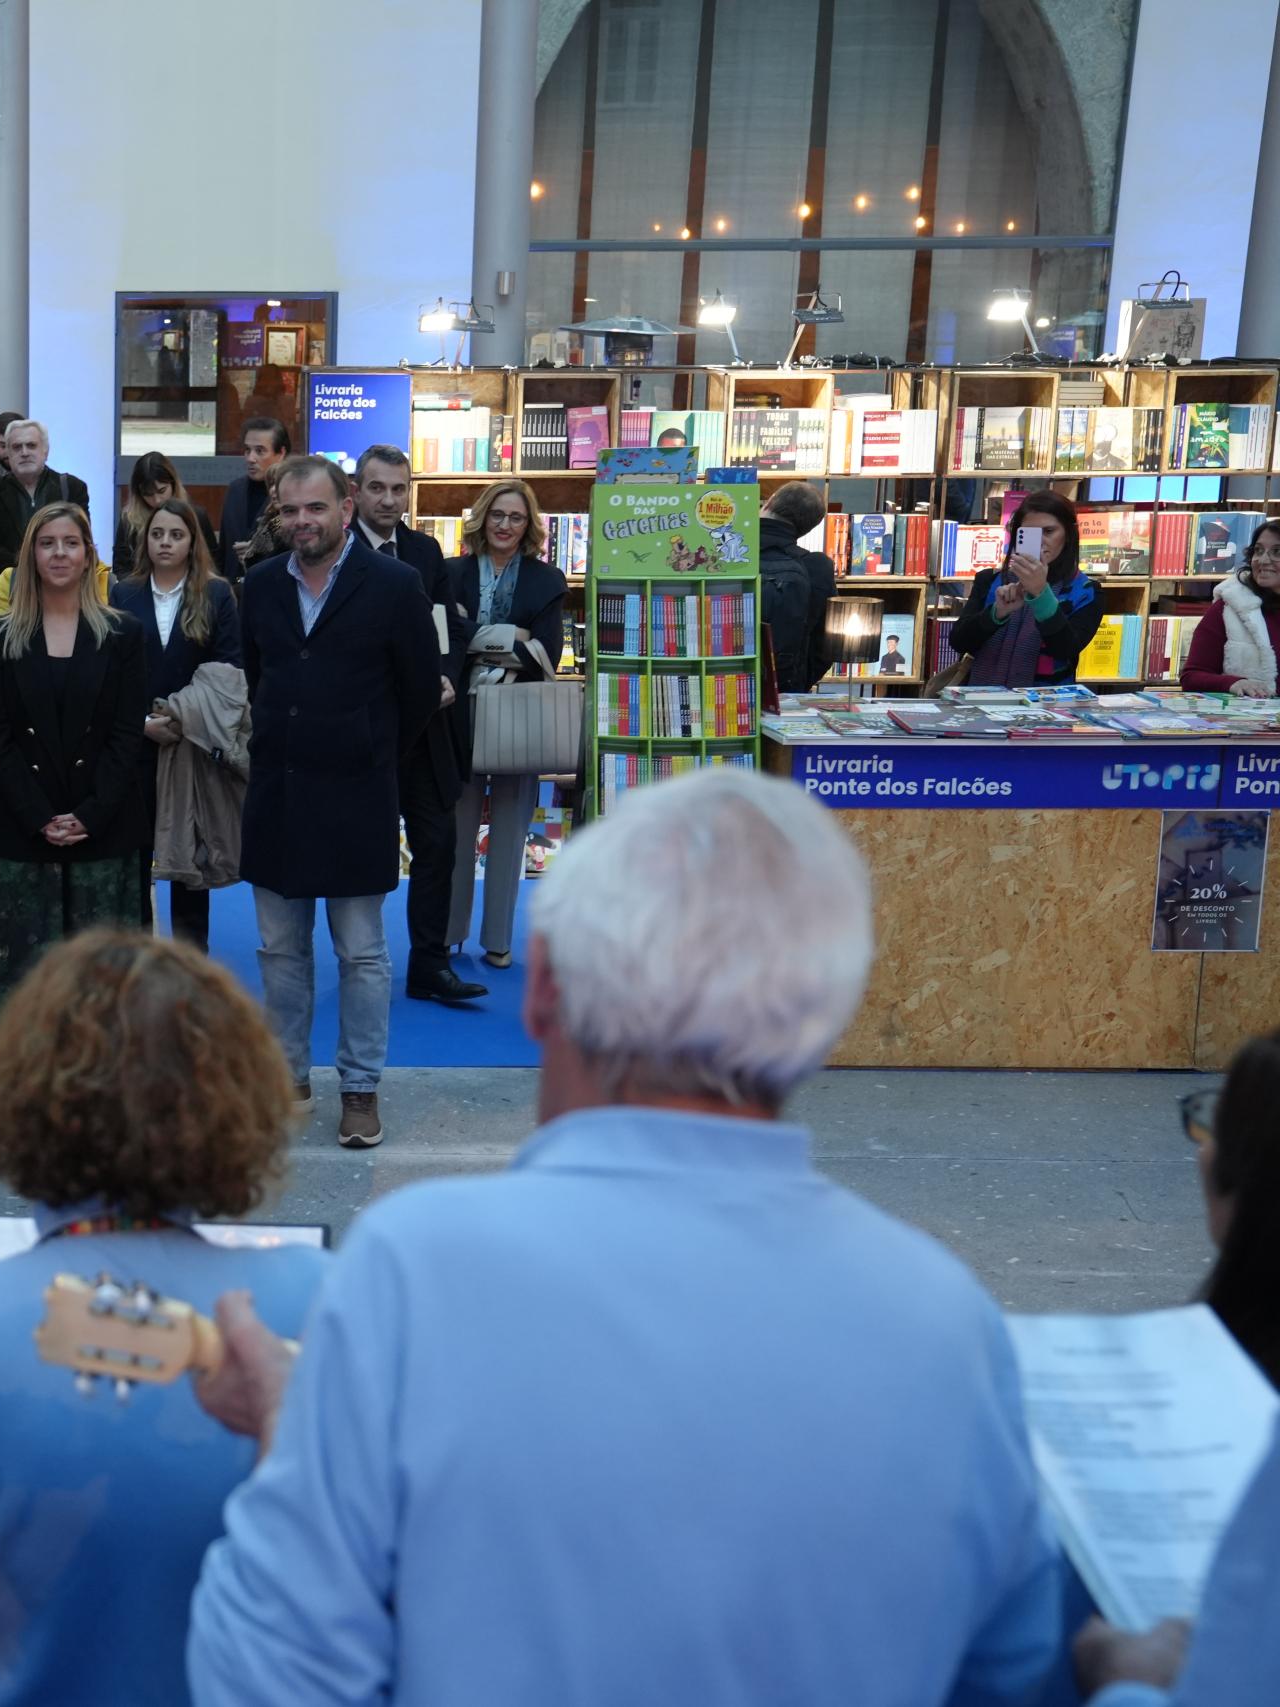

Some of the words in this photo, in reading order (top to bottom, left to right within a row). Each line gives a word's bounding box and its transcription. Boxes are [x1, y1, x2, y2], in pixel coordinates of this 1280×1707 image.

[315, 384, 363, 396] Livraria
[315, 397, 351, 408] Ponte
[353, 397, 377, 408] dos
[315, 409, 363, 420] Falcões
[766, 412, 789, 421] TODAS
[762, 437, 790, 446] FELIZES
[609, 495, 622, 506] O
[634, 507, 656, 515] DAS
[707, 503, 733, 514] Milhão
[806, 755, 893, 774] Livraria
[805, 779, 872, 796] Ponte
[875, 778, 918, 796] dos
[923, 777, 1012, 796] Falcões
[1190, 883, 1227, 899] 20%
